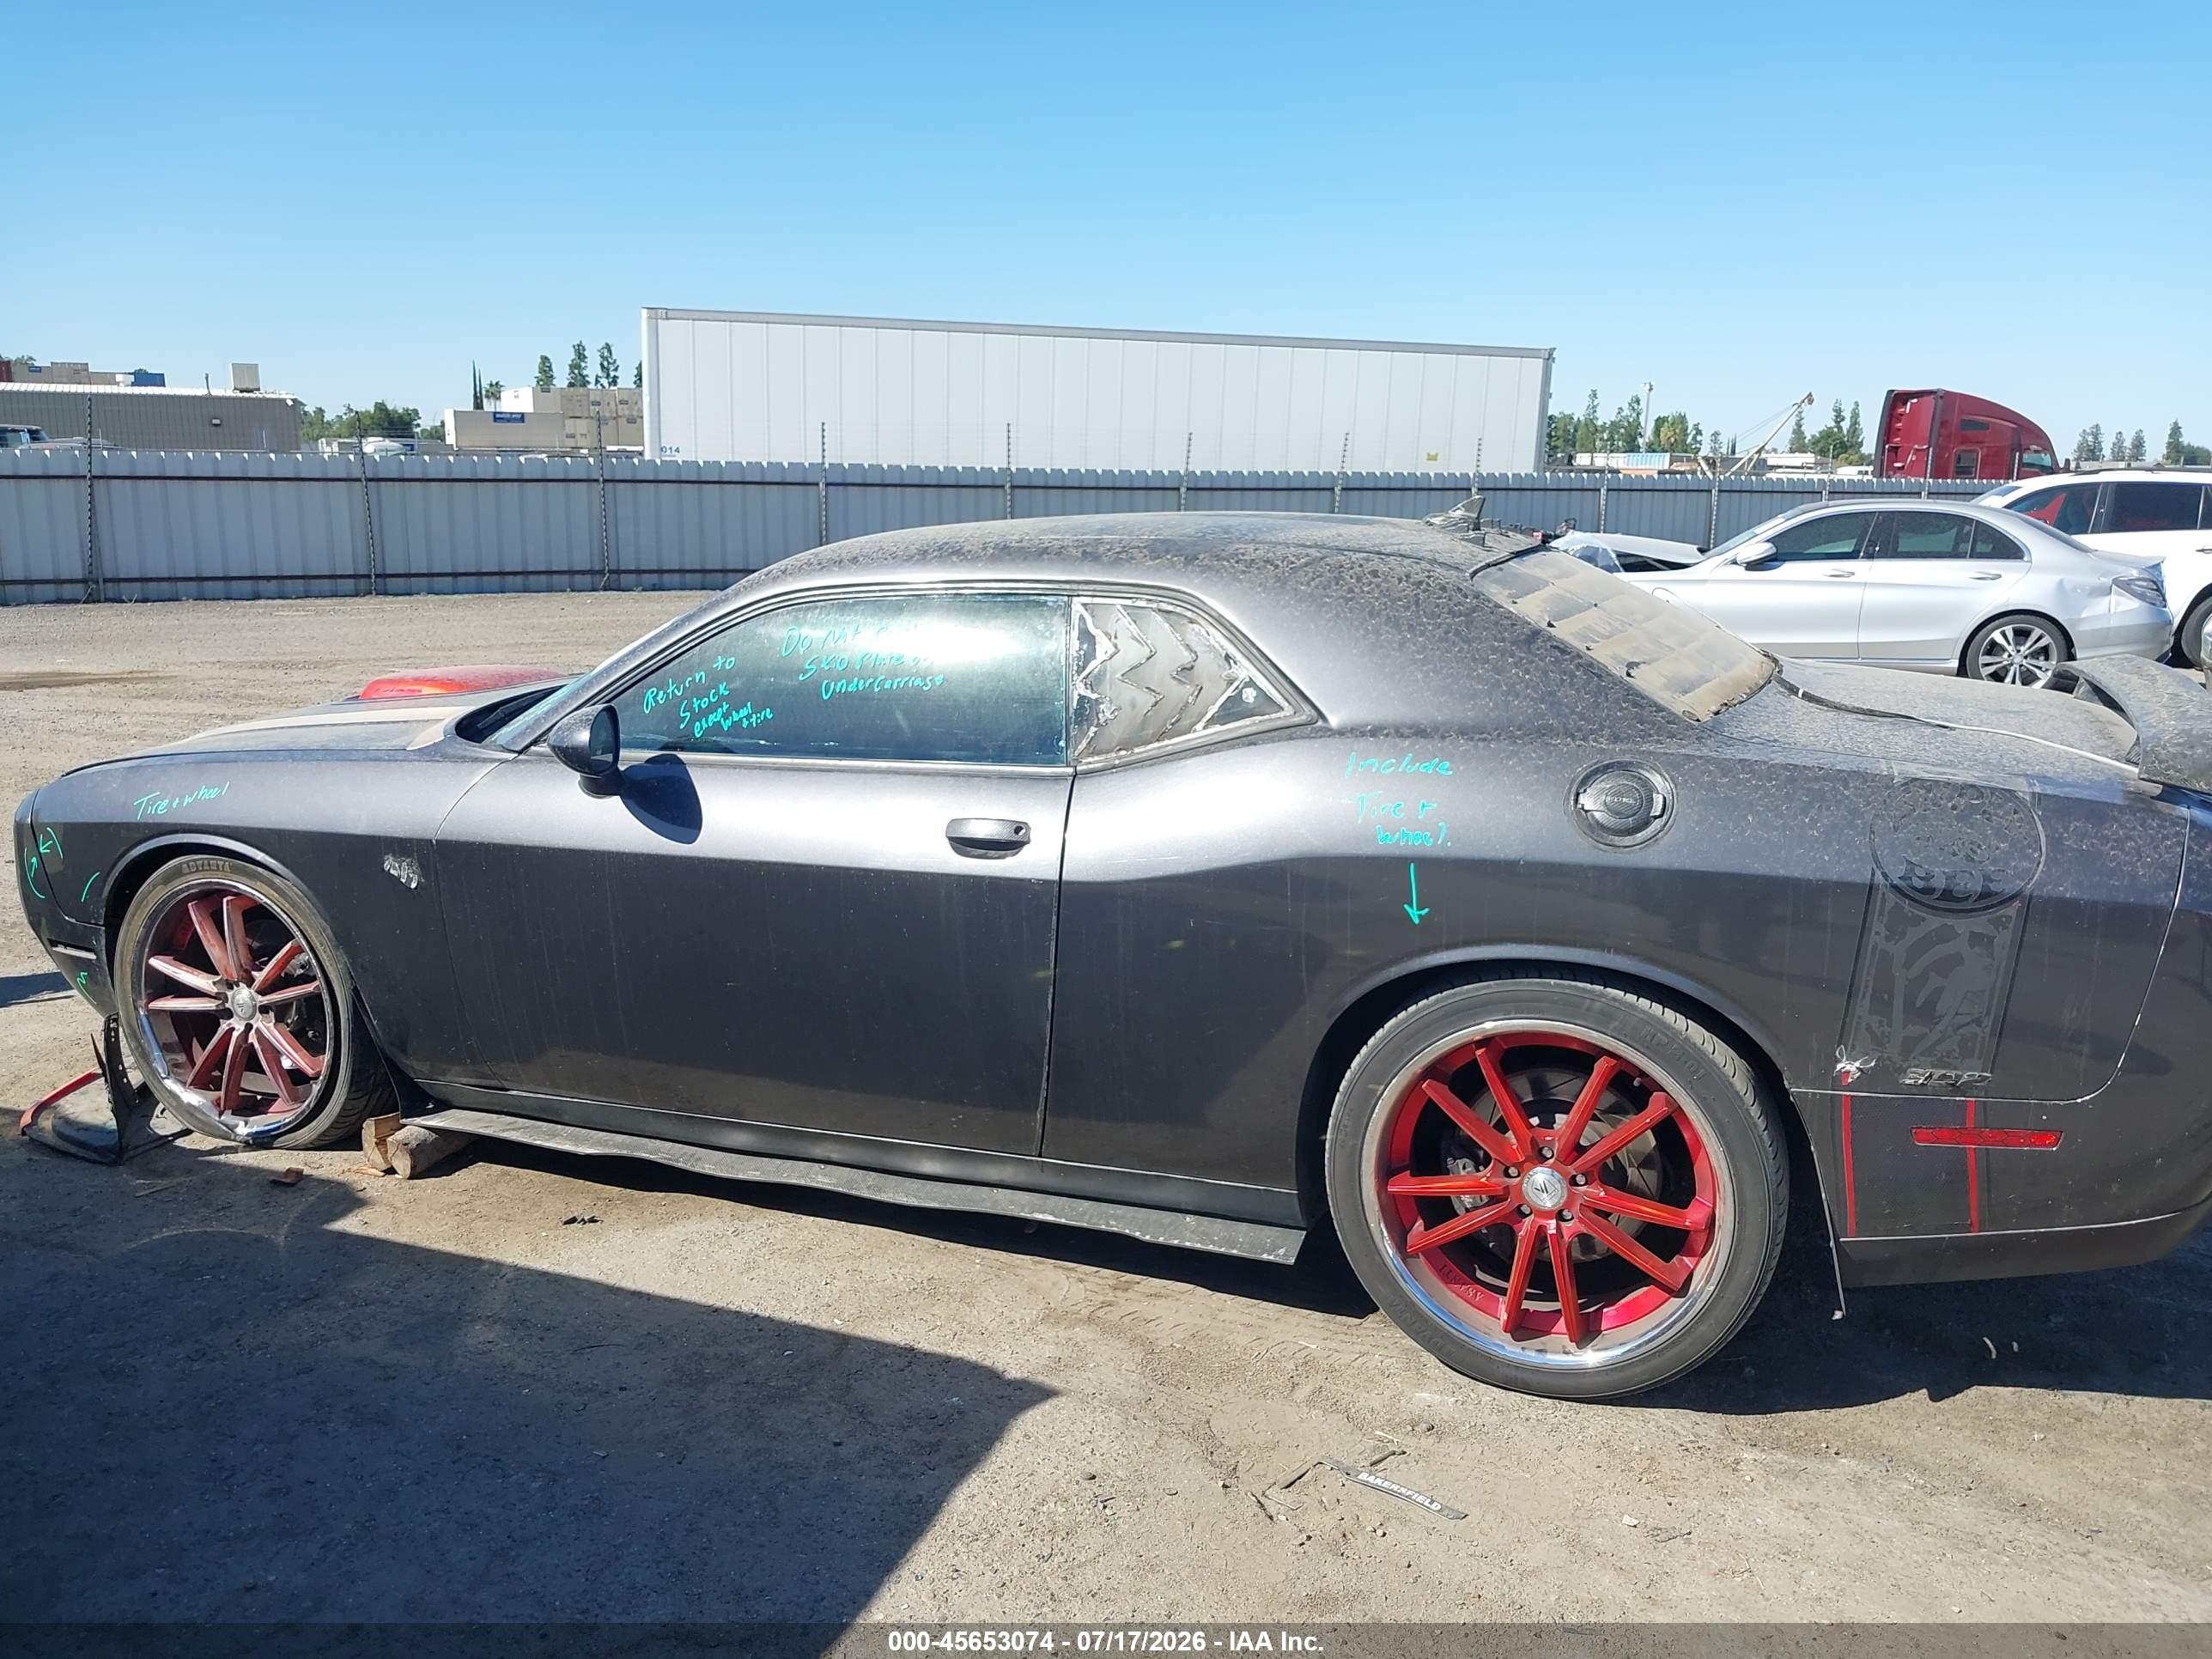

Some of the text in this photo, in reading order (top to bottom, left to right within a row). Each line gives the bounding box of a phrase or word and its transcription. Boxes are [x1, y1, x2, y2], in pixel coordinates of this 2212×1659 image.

[643, 671, 706, 714] Return
[1345, 751, 1455, 780] Include
[133, 791, 169, 821] Tire
[1357, 1472, 1443, 1511] BAKERSFIELD
